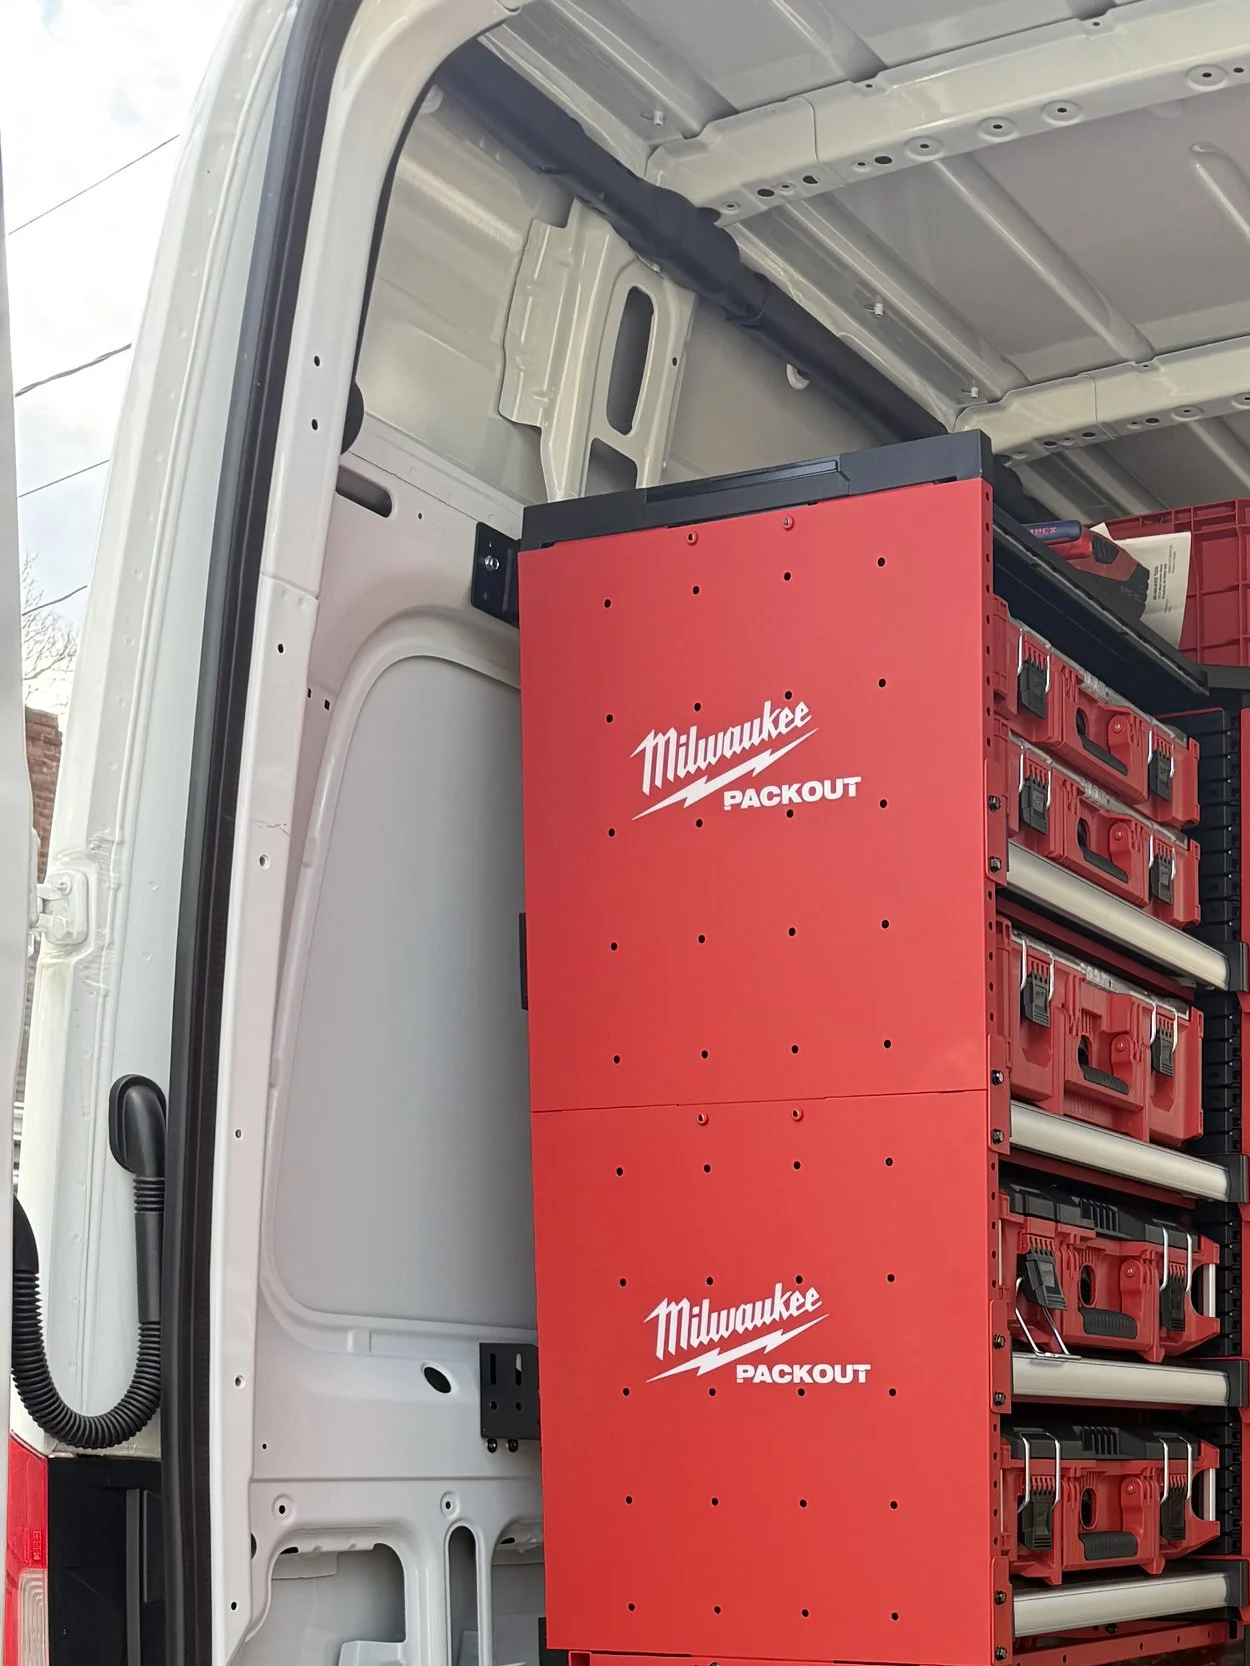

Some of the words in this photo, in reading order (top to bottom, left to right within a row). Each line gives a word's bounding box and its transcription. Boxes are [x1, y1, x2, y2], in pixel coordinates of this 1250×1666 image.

[630, 700, 812, 796] Milwaukee
[723, 776, 862, 811] PACKOUT
[643, 1282, 823, 1361] Milwaukee
[736, 1363, 871, 1384] PACKOUT
